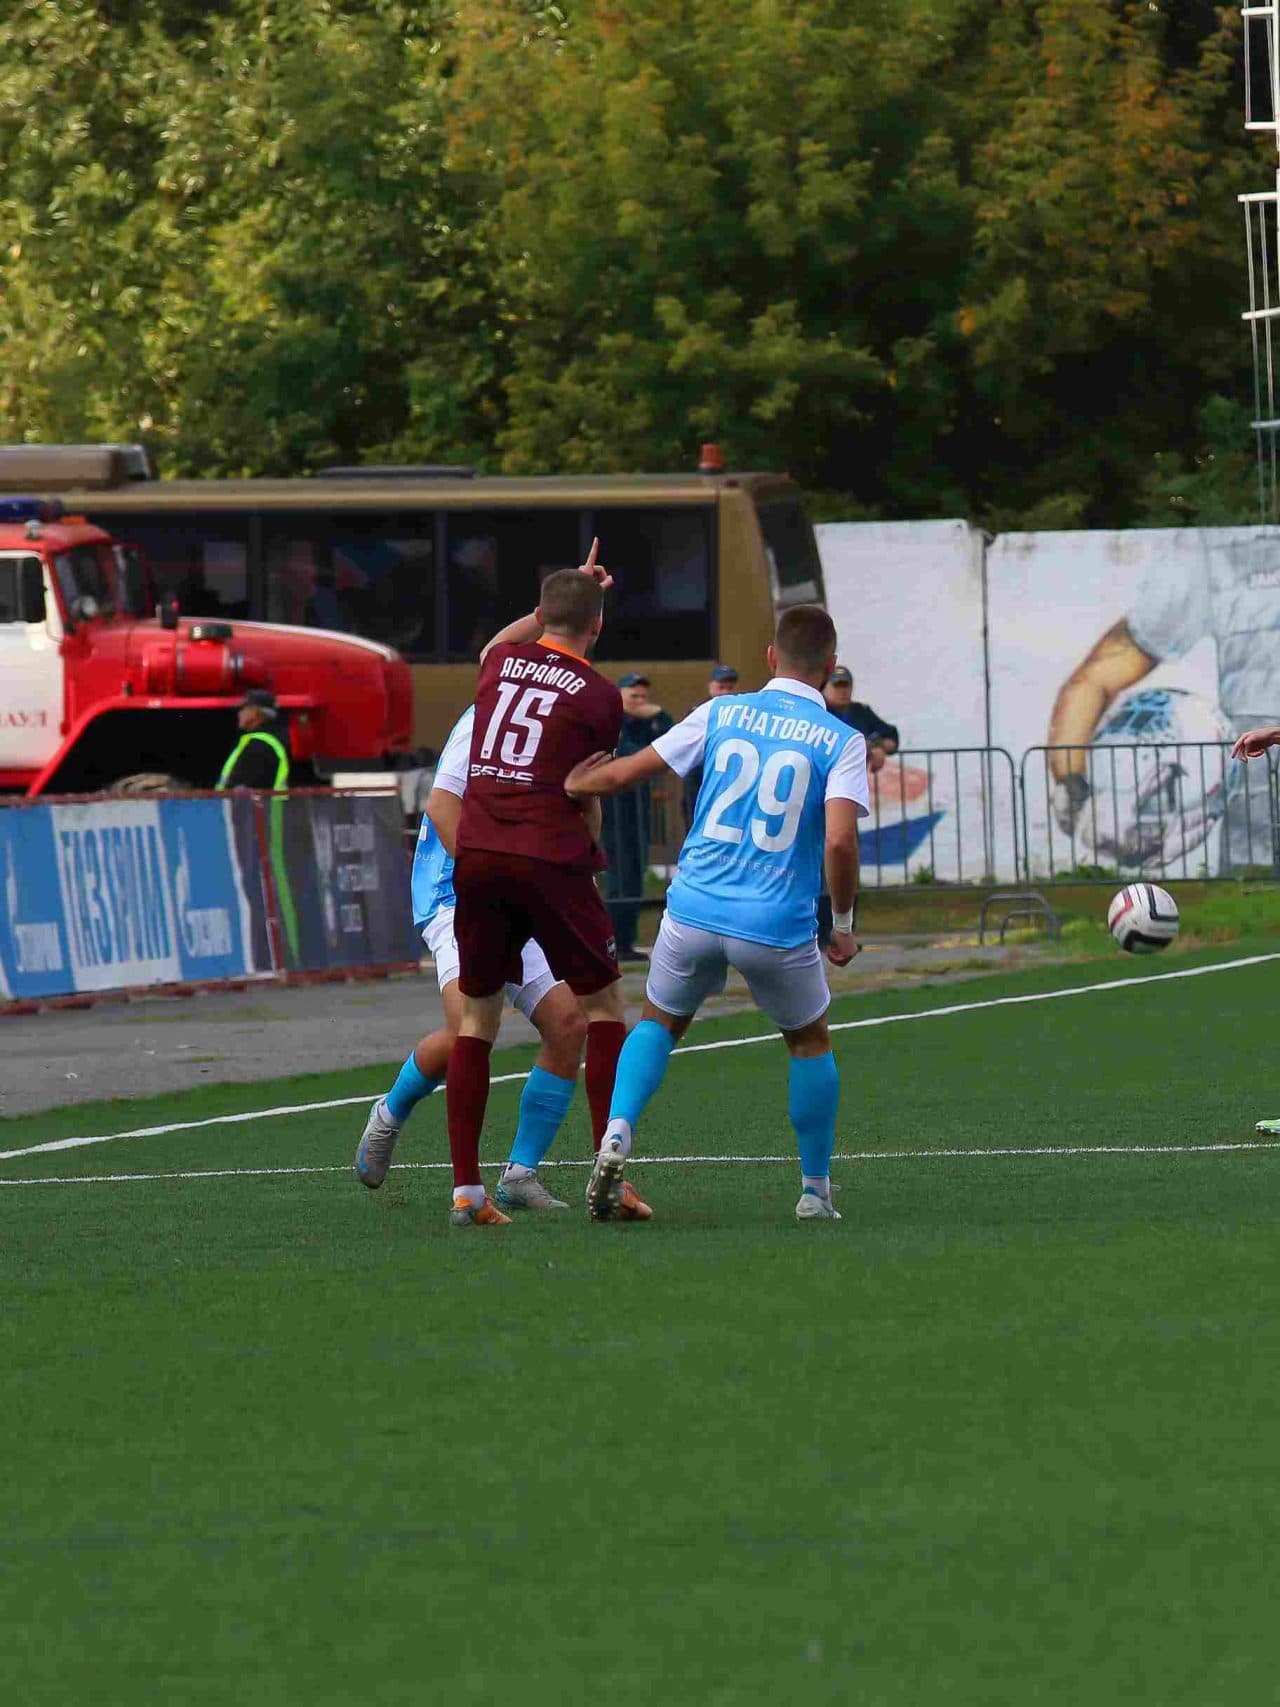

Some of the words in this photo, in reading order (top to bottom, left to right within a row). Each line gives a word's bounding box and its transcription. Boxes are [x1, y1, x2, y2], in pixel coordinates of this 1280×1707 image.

[500, 657, 586, 695] АБРАМОВ
[0, 709, 48, 729] АУЛ
[480, 681, 559, 767] 15
[716, 704, 840, 756] ИГНАТОВИЧ
[702, 738, 812, 853] 29
